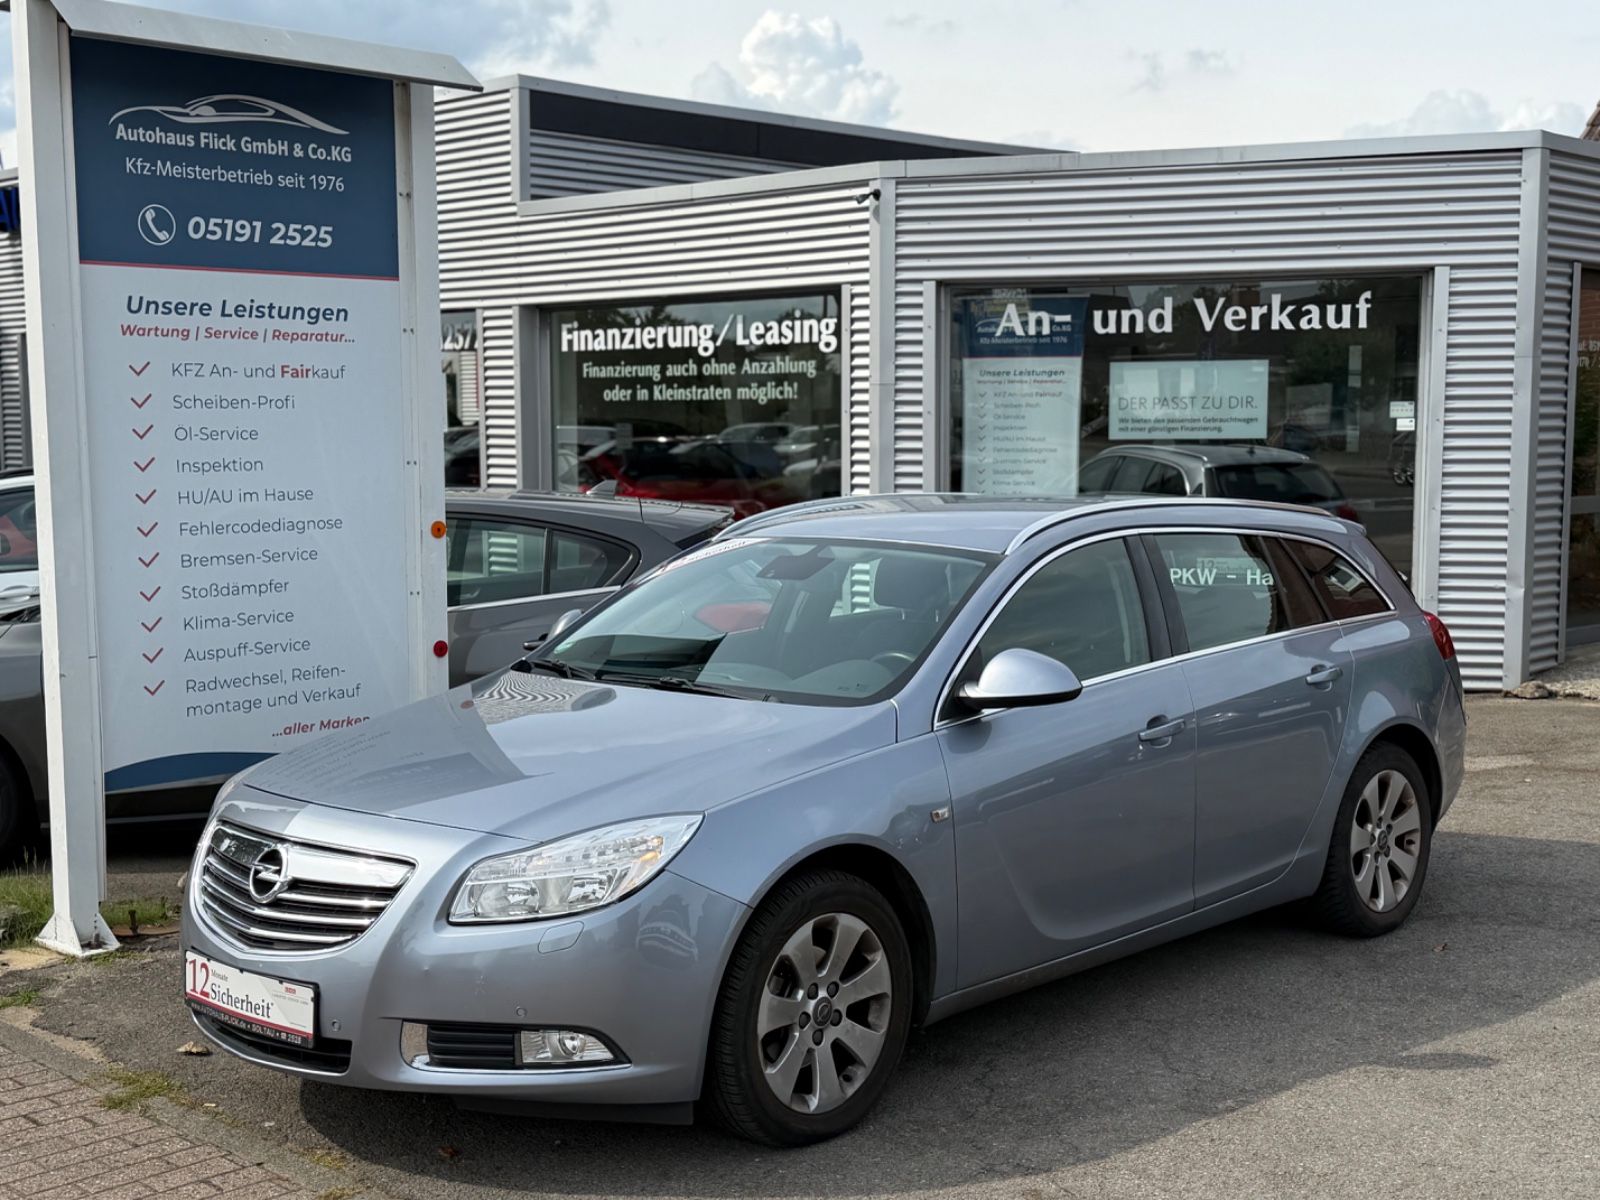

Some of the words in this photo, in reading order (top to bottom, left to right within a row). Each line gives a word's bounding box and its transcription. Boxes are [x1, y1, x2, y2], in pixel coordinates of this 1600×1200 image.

[115, 123, 195, 147] Autohaus
[200, 131, 237, 151] Flick
[240, 136, 289, 157] GmbH
[293, 142, 304, 158] &
[307, 143, 352, 162] Co.KG
[125, 157, 273, 186] Kfz-Meisterbetrieb
[278, 172, 306, 189] seit
[309, 174, 345, 192] 1976
[187, 215, 262, 243] 05191
[269, 222, 333, 248] 2525
[126, 295, 213, 317] Unsere
[220, 298, 349, 325] Leistungen
[995, 303, 1072, 336] An-
[1093, 297, 1173, 335] und
[1194, 290, 1372, 332] Verkauf
[120, 323, 191, 341] Wartung
[204, 326, 259, 340] Service
[271, 329, 355, 344] Reparatur...
[171, 362, 205, 378] KFZ
[209, 362, 238, 378] An-
[243, 363, 276, 378] und
[280, 364, 346, 379] Fairkauf
[582, 361, 661, 381] Finanzierung
[666, 358, 698, 376] auch
[702, 358, 736, 376] ohne
[741, 356, 817, 377] Anzahlung
[1013, 368, 1065, 378] Leistungen
[172, 394, 296, 410] Scheiben-Profi
[603, 386, 632, 401] oder
[636, 385, 649, 400] in
[653, 384, 732, 401] Kleinstraten
[736, 381, 799, 405] möglich!
[1118, 396, 1147, 411] DER
[1152, 395, 1197, 410] PASST
[1201, 395, 1223, 409] ZU
[1228, 394, 1258, 409] DIR.
[174, 424, 259, 442] Öl-Service
[176, 457, 264, 474] Inspektion
[177, 488, 233, 506] HU/AU
[238, 488, 260, 503] im
[264, 487, 314, 502] Hause
[179, 516, 344, 538] Fehlercodediagnose
[180, 547, 319, 569] Bremsen-Service
[1169, 567, 1217, 587] PKW
[181, 579, 290, 601] Stoßdämpfer
[183, 609, 295, 632] Klima-Service
[183, 638, 311, 663] Auspuff-Service
[186, 669, 287, 694] Radwechsel,
[291, 665, 346, 681] Reifen-
[186, 696, 262, 718] montage
[267, 691, 298, 707] und
[302, 683, 362, 703] Verkauf
[188, 958, 210, 999] 12
